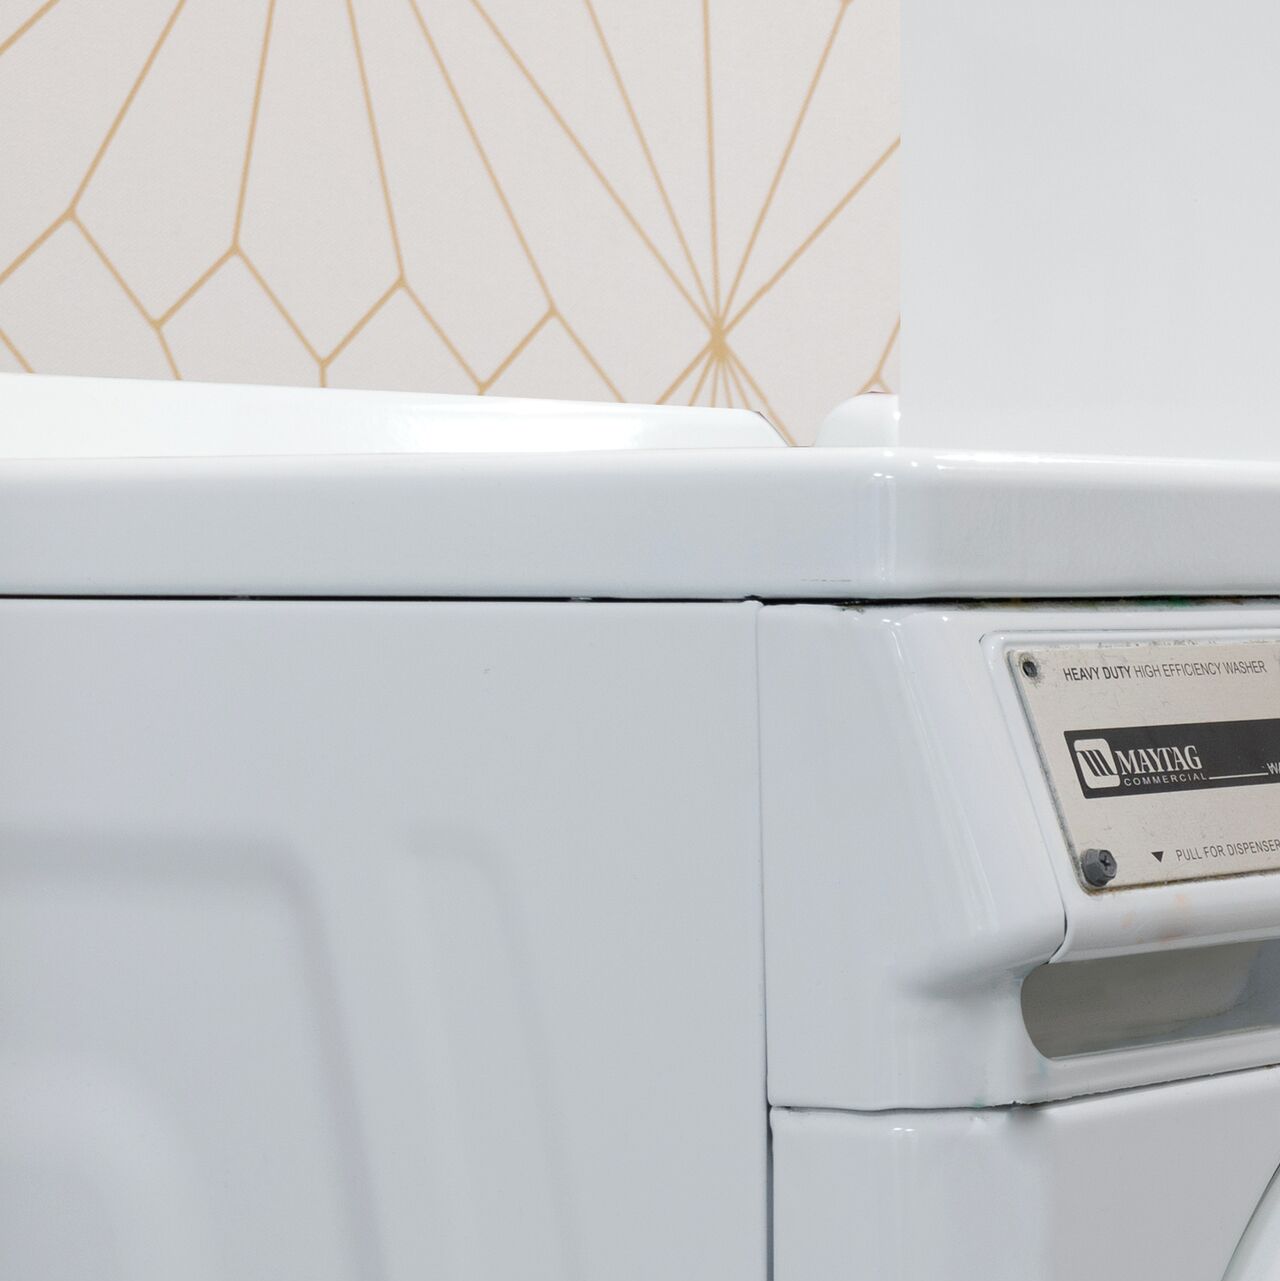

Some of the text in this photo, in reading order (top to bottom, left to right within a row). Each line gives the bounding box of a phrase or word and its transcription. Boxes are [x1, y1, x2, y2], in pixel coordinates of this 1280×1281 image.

[1063, 660, 1268, 682] HEAVY DUTY HIGH EFFICIENCY WASHER
[1115, 745, 1202, 775] MAYTAG
[1123, 772, 1208, 787] COMMERCIAL
[1176, 848, 1203, 862] PULL
[1204, 846, 1226, 859] FOR
